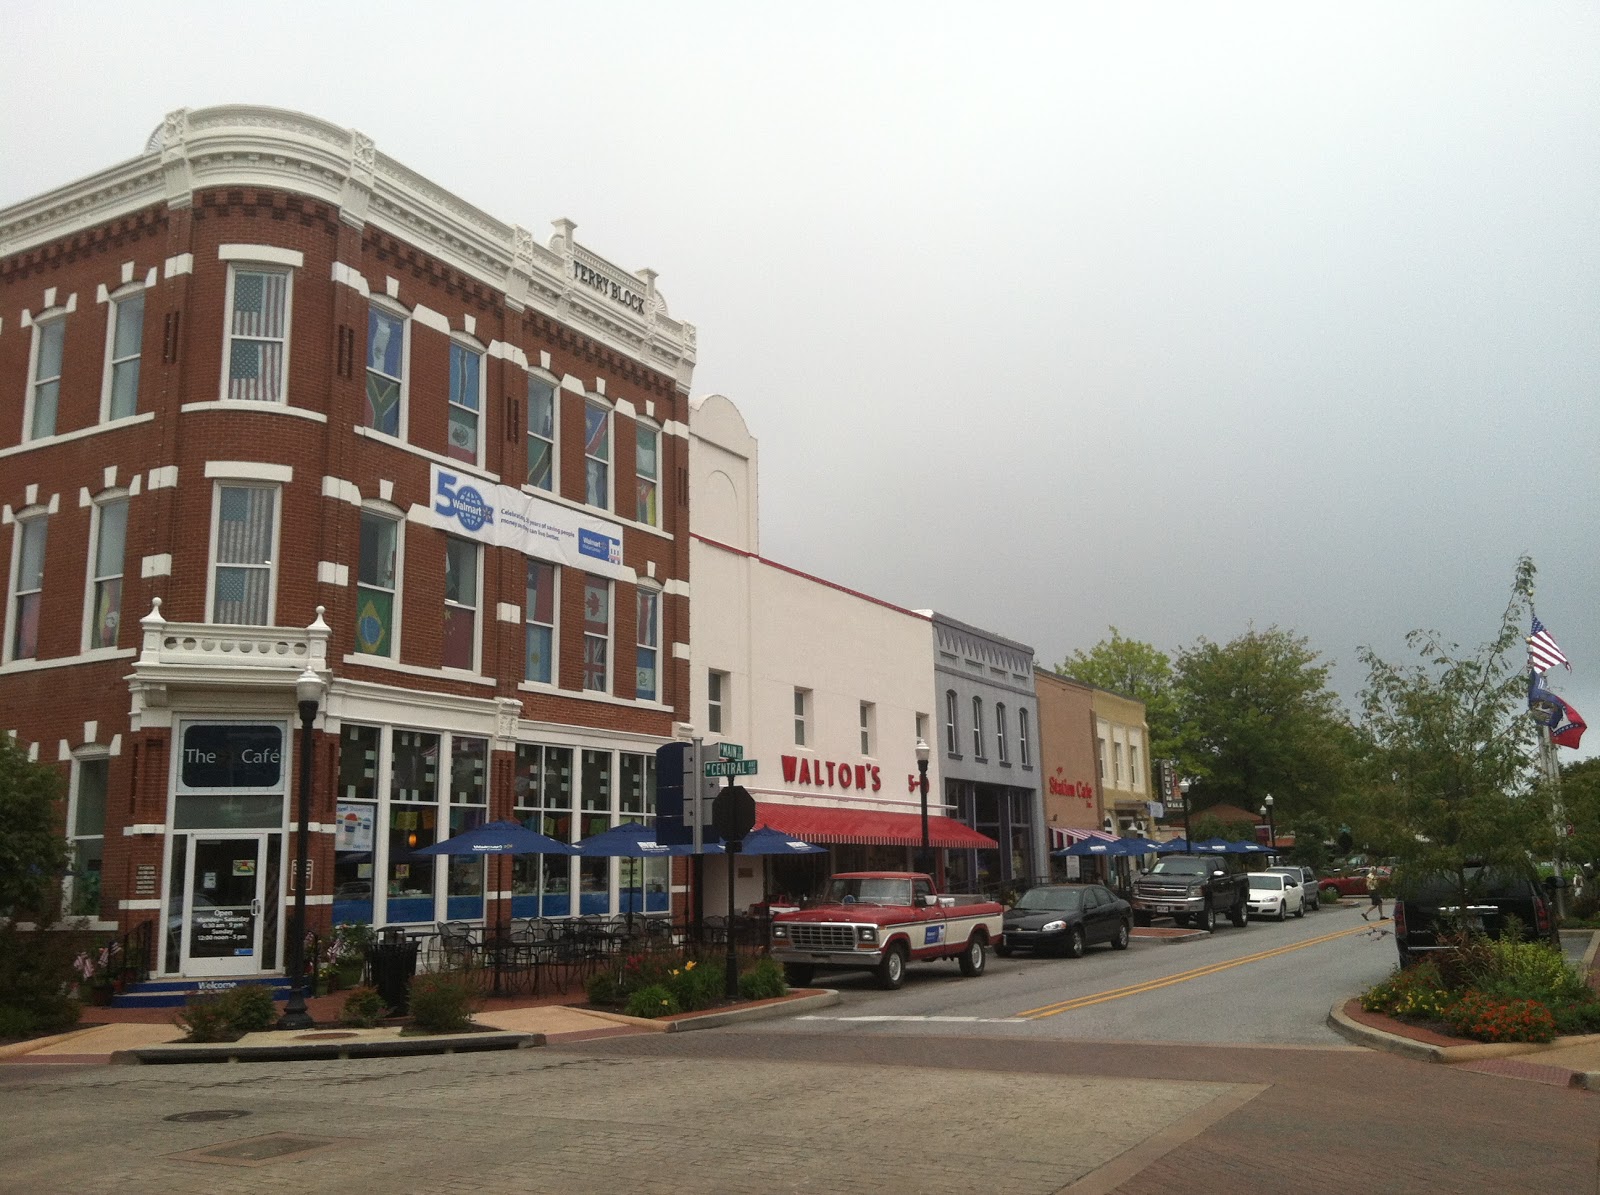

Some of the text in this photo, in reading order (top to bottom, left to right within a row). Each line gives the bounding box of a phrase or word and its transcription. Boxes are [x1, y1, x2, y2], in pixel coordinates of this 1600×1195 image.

[573, 260, 645, 315] TERRY BLOCK
[452, 498, 482, 517] Walmart
[547, 525, 560, 534] saving
[560, 530, 575, 538] people
[184, 748, 280, 764] The Café
[722, 744, 737, 758] MAIN
[711, 762, 747, 776] CENTRAL
[781, 755, 881, 792] WALTON'S
[197, 981, 237, 990] Welcome
